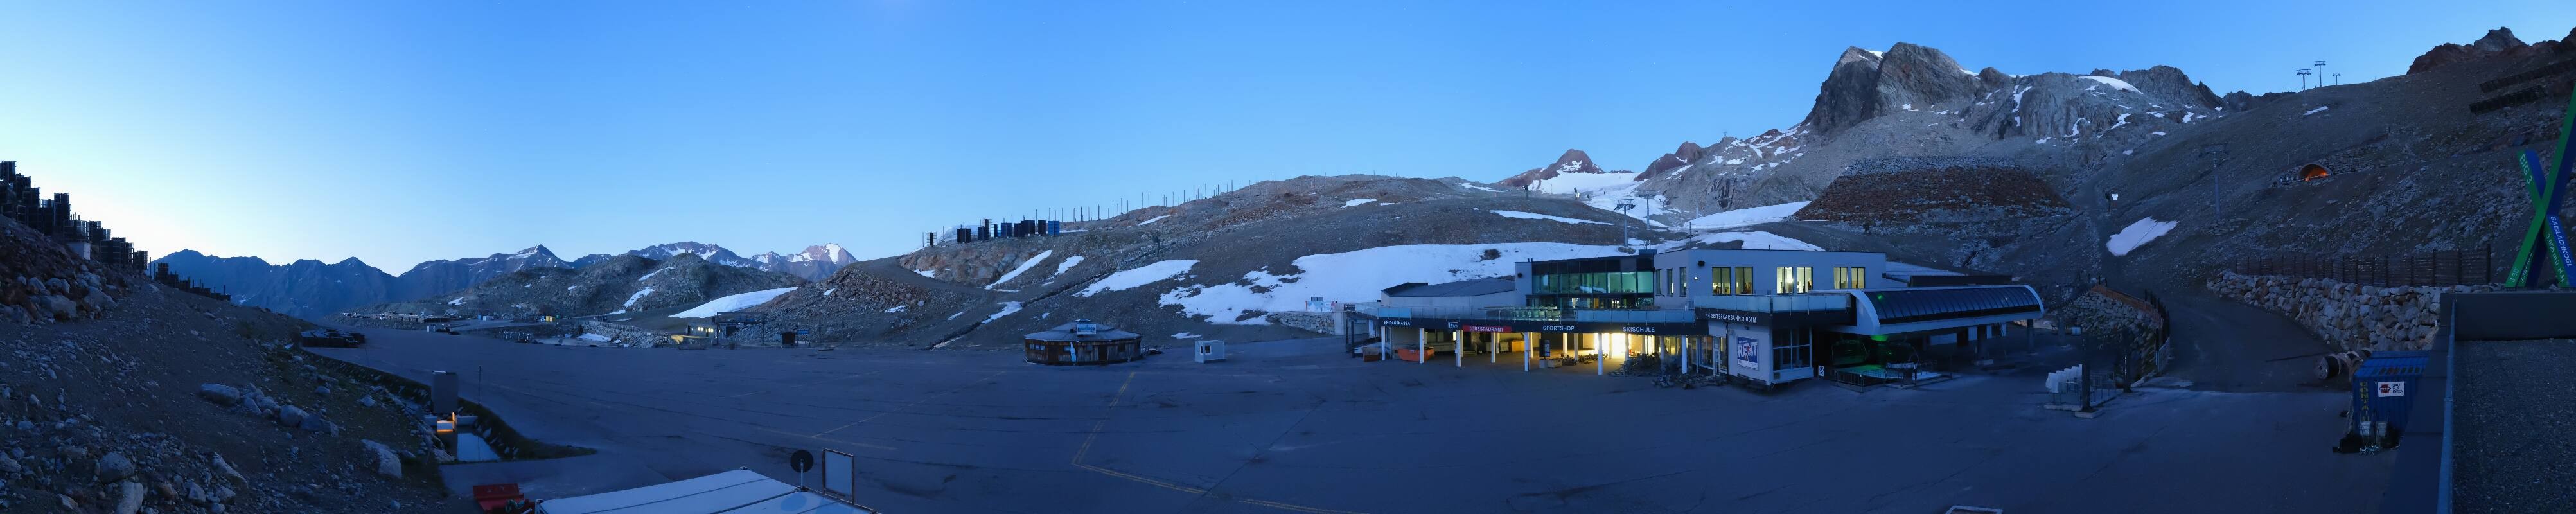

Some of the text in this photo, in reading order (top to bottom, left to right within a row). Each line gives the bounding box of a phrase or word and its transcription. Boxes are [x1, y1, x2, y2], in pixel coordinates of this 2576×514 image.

[2520, 154, 2532, 184] BIG 3
[2550, 216, 2573, 268] GAISLACHKOGL
[1737, 342, 1758, 357] RENT
